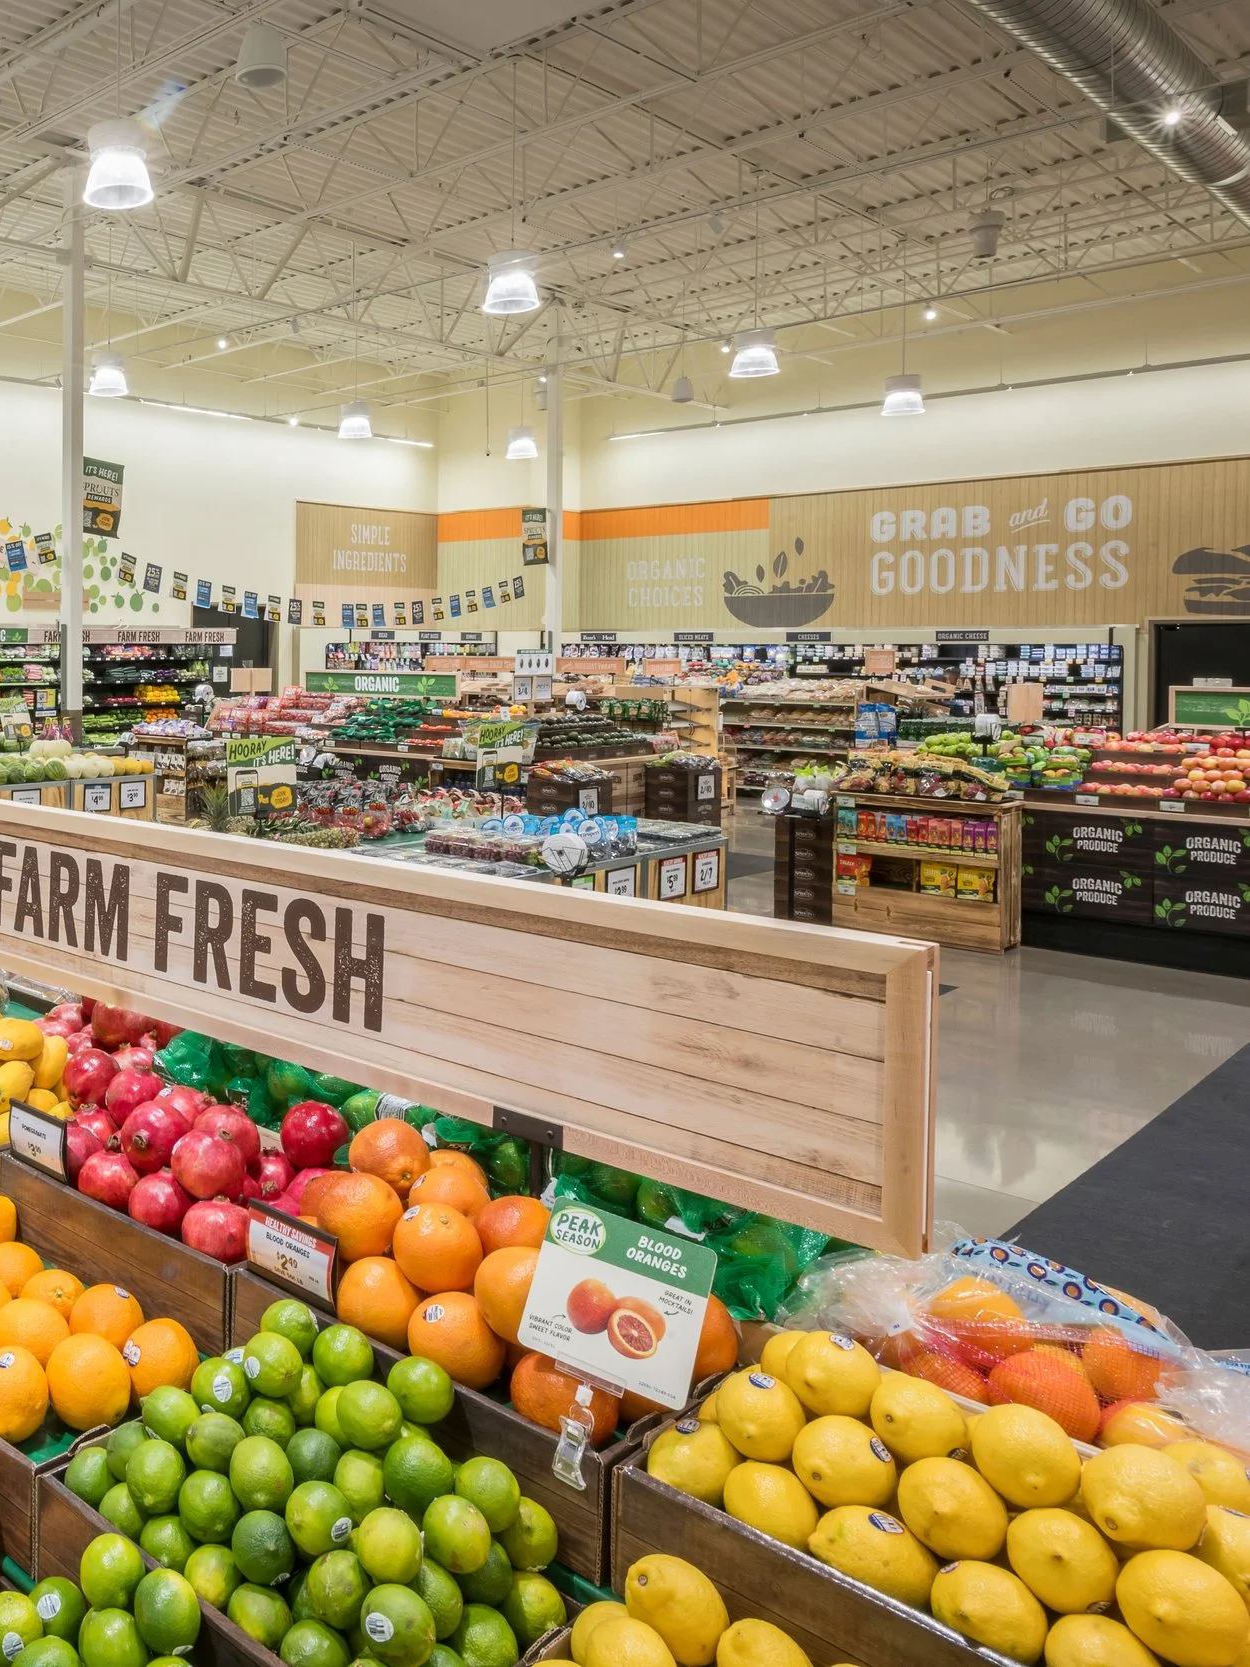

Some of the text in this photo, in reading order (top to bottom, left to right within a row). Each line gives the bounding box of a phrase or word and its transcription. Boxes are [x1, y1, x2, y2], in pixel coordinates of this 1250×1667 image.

[85, 465, 118, 482] IT'S HERE!
[83, 481, 120, 497] PROUTS
[87, 494, 111, 504] REWARDS
[870, 494, 1133, 544] GRAB and GO
[350, 523, 391, 546] SIMPLE
[333, 549, 407, 573] INGREDIENTS
[627, 558, 706, 581] ORGANIC
[870, 539, 1130, 596] GOODNESS
[628, 586, 704, 608] CHOICES
[117, 630, 160, 643] FARM FRESH
[185, 631, 225, 643] FARM FRESH
[937, 632, 963, 640] ORGANIC
[354, 676, 400, 693] ORGANIC
[479, 725, 506, 743] HOORAY
[505, 728, 524, 746] HERE!
[229, 740, 267, 760] HOORAY
[253, 744, 294, 767] IT'S HERE!
[1072, 826, 1123, 843] ORGANIC
[1076, 839, 1119, 853] PRODUCE
[1185, 836, 1241, 854] ORGANIC
[1190, 850, 1237, 865] PRODUCE
[1072, 878, 1123, 895] ORGANIC
[1076, 891, 1118, 906] PRODUCE
[1185, 890, 1241, 909] ORGANIC
[1189, 904, 1236, 920] PRODUCE
[154, 872, 385, 1033] FRESH
[265, 1216, 317, 1248] HEALTHY SAVINGS
[556, 1212, 603, 1237] PEAK
[266, 1232, 311, 1258] BLOOD ORANGES
[555, 1229, 600, 1250] SEASON
[638, 1235, 682, 1260] BLOOD
[626, 1247, 688, 1279] ORANGES
[659, 1296, 693, 1315] MOCKTAILS!
[664, 1289, 692, 1306] GREAT IN
[528, 1323, 571, 1341] SWEET FLAVOR
[529, 1314, 573, 1334] VIBRANT COLOR
